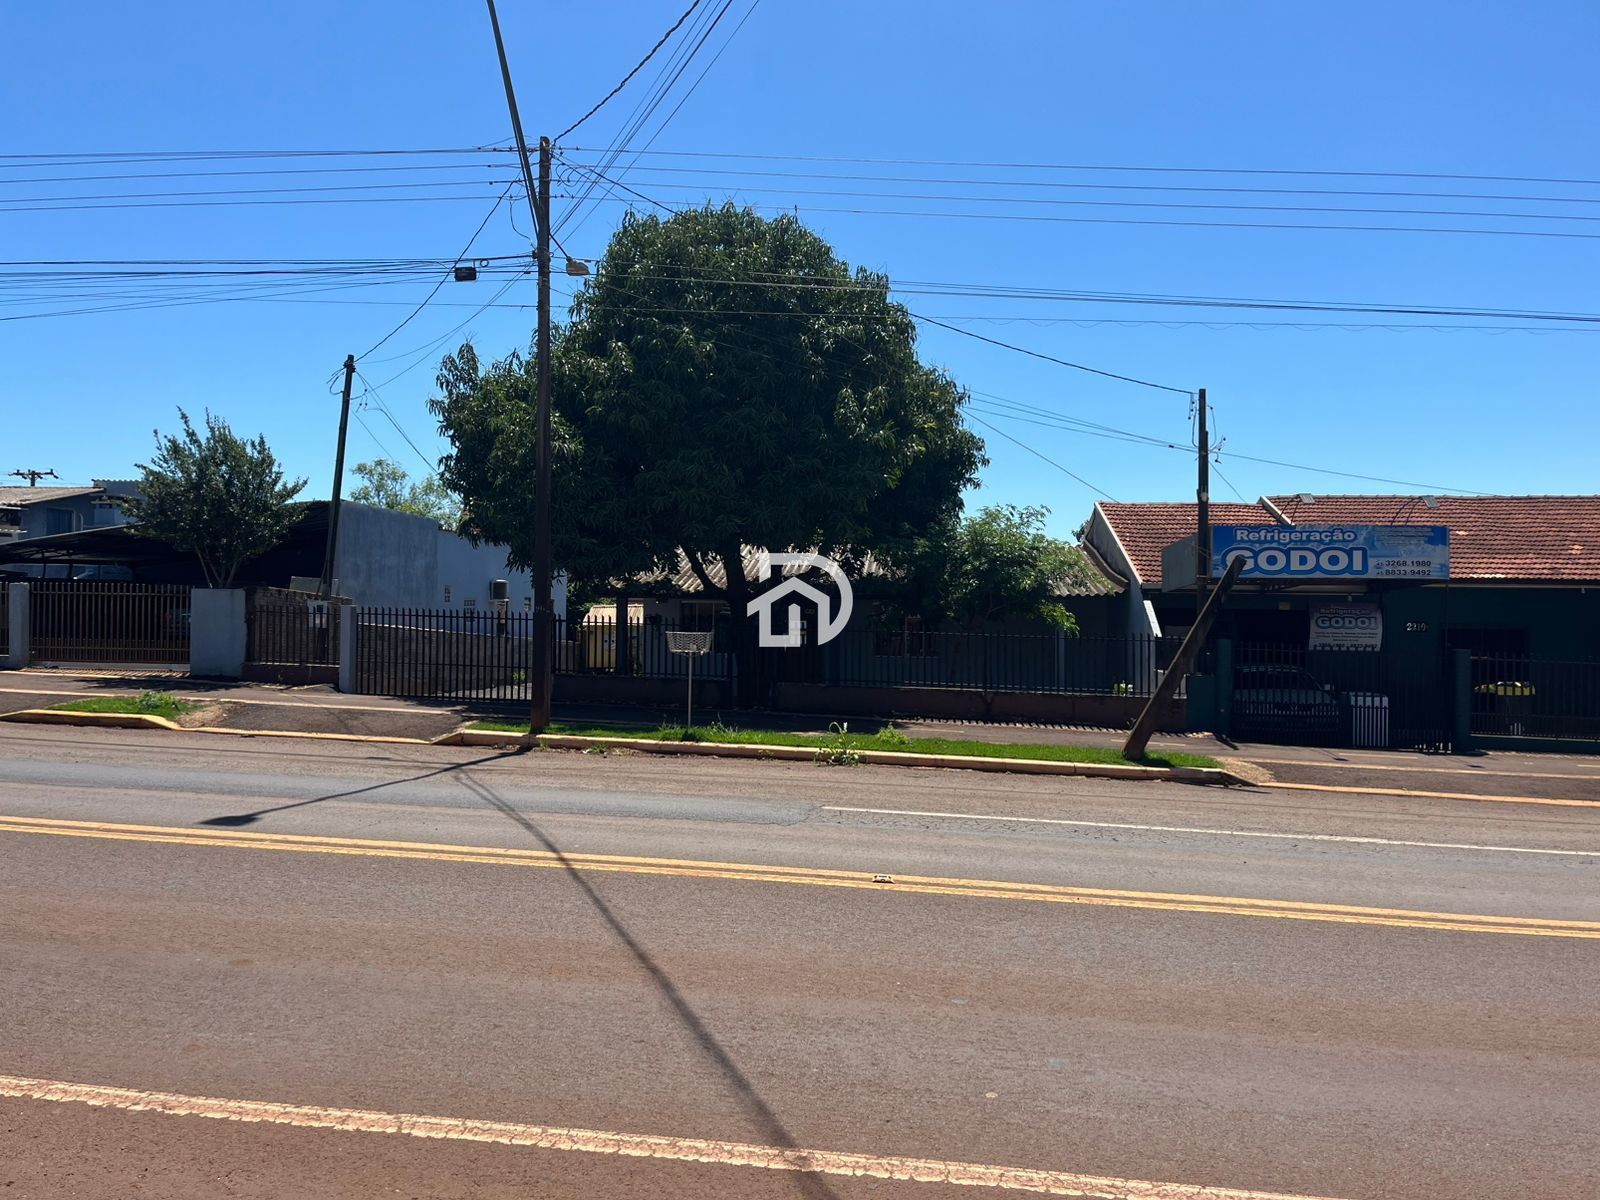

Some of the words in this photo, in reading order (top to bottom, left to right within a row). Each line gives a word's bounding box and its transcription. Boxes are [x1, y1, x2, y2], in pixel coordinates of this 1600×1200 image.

[1236, 528, 1355, 543] Refrigeração
[1226, 549, 1363, 571] GODOI
[1317, 617, 1376, 627] GODOI
